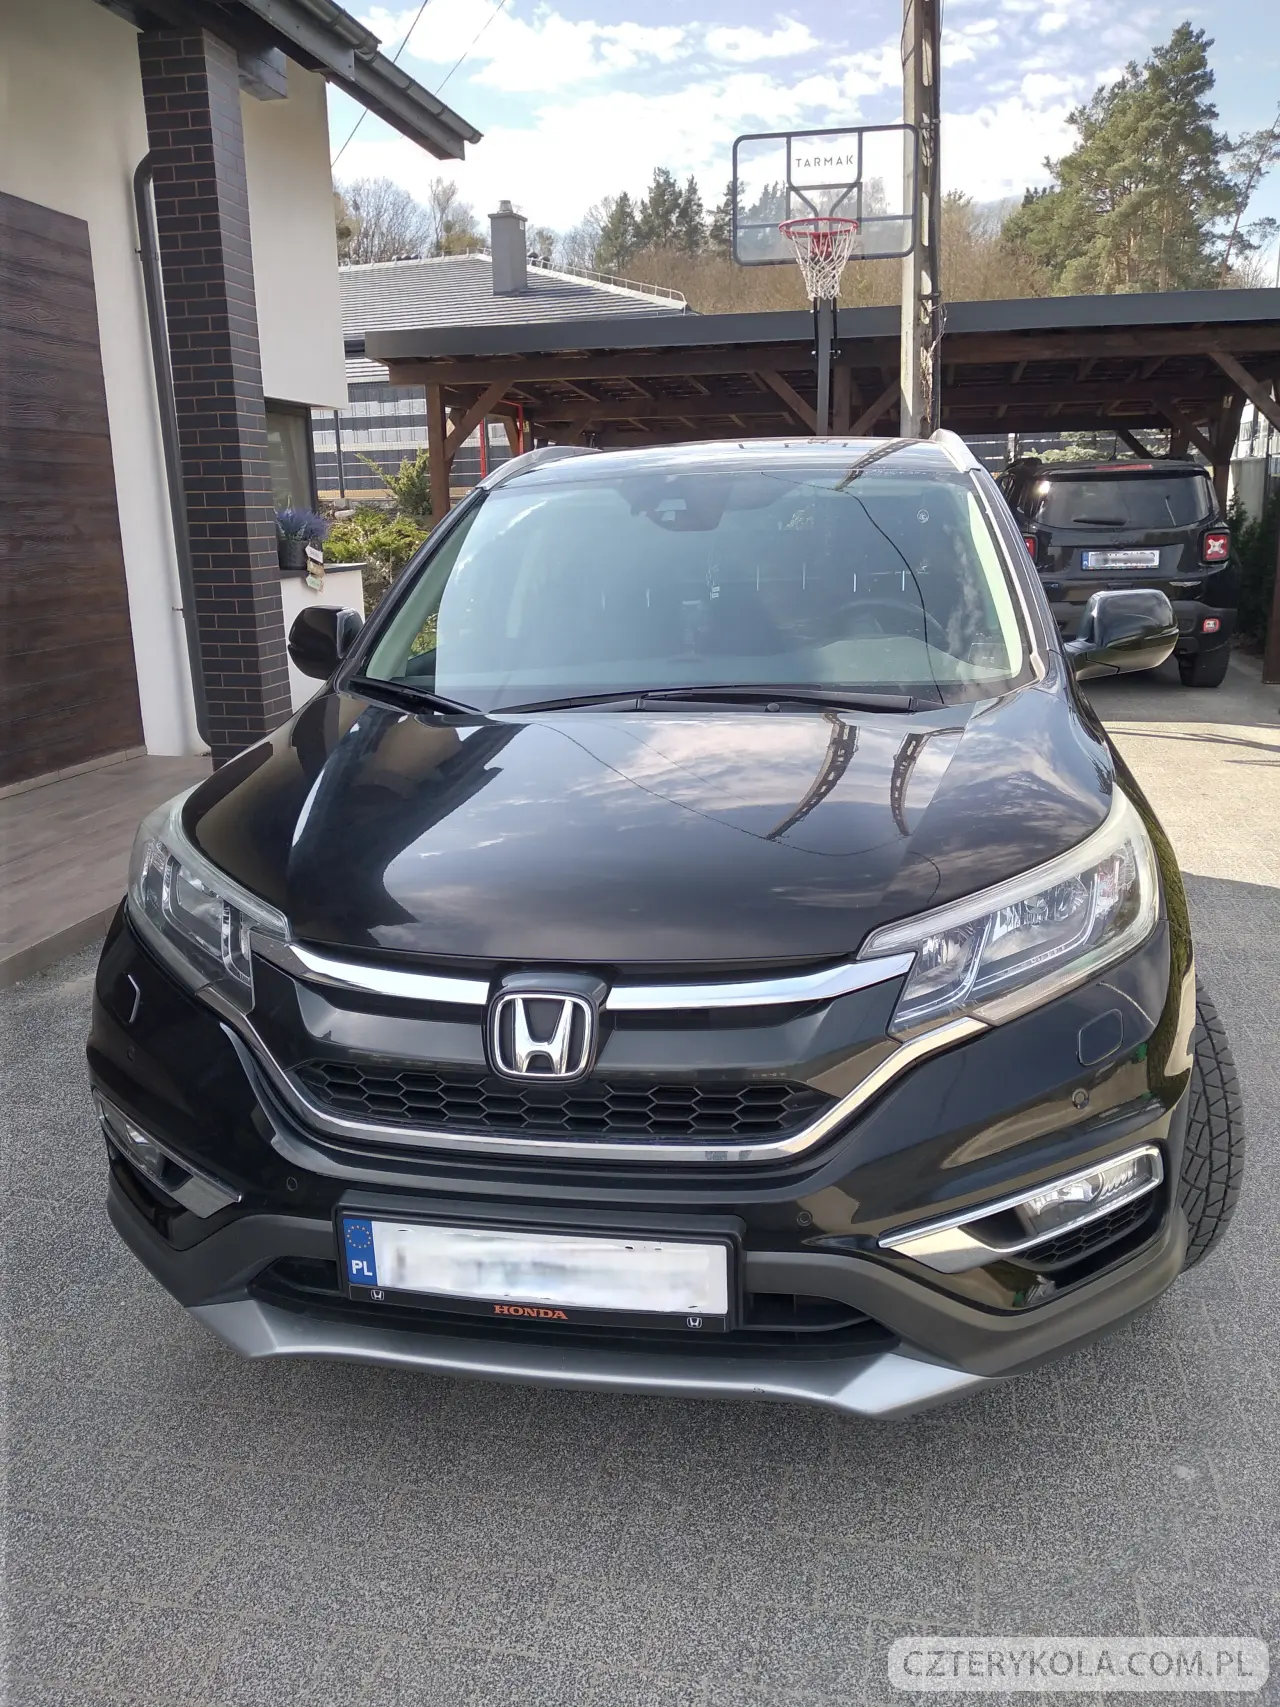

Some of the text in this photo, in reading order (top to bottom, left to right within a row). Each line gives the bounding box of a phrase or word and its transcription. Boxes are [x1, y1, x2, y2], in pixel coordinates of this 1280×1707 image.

[795, 154, 854, 168] TARMAK
[351, 1259, 373, 1276] PL
[493, 1304, 569, 1320] HONDA
